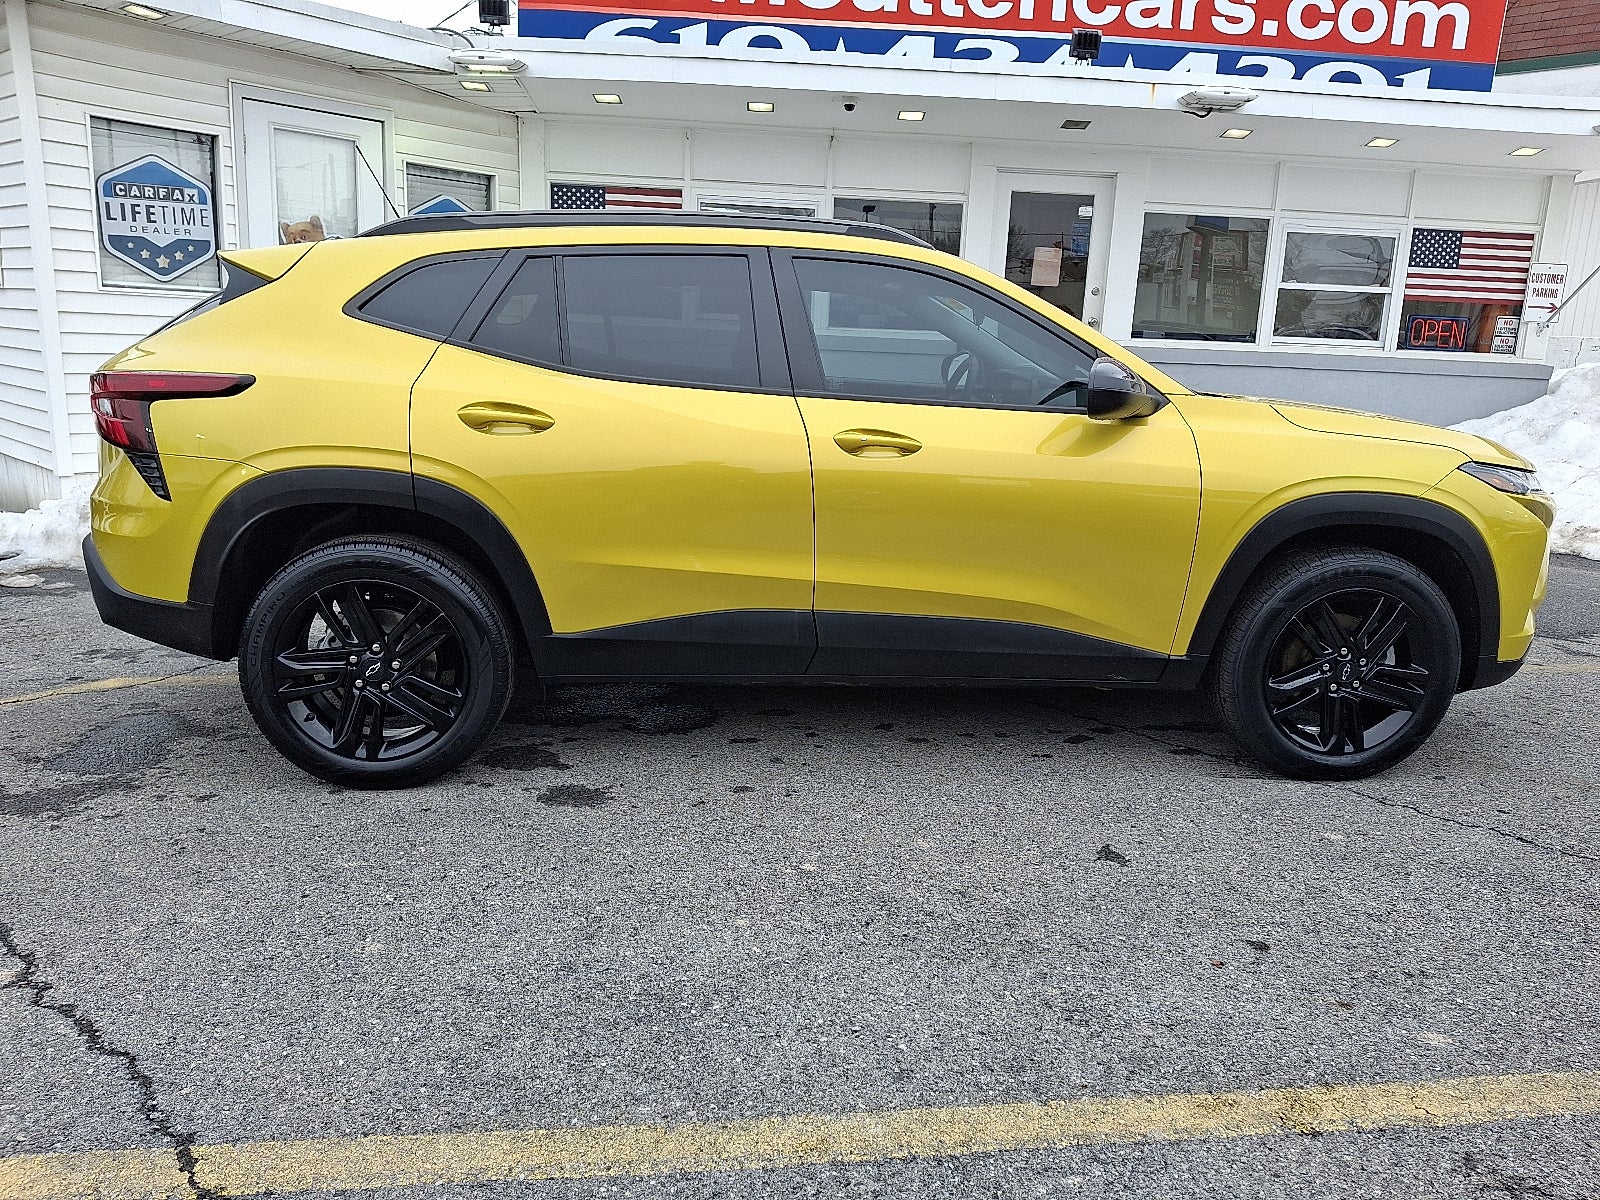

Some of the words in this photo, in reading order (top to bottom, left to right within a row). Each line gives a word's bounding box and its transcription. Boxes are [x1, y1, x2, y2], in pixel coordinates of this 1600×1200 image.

[114, 183, 198, 203] CARFAX
[104, 201, 210, 227] LIFETIME
[129, 225, 192, 236] DEALER
[1531, 272, 1565, 285] CUSTOMER
[1532, 287, 1559, 299] PARKING
[1503, 319, 1514, 327] NO
[1411, 319, 1466, 347] OPEN
